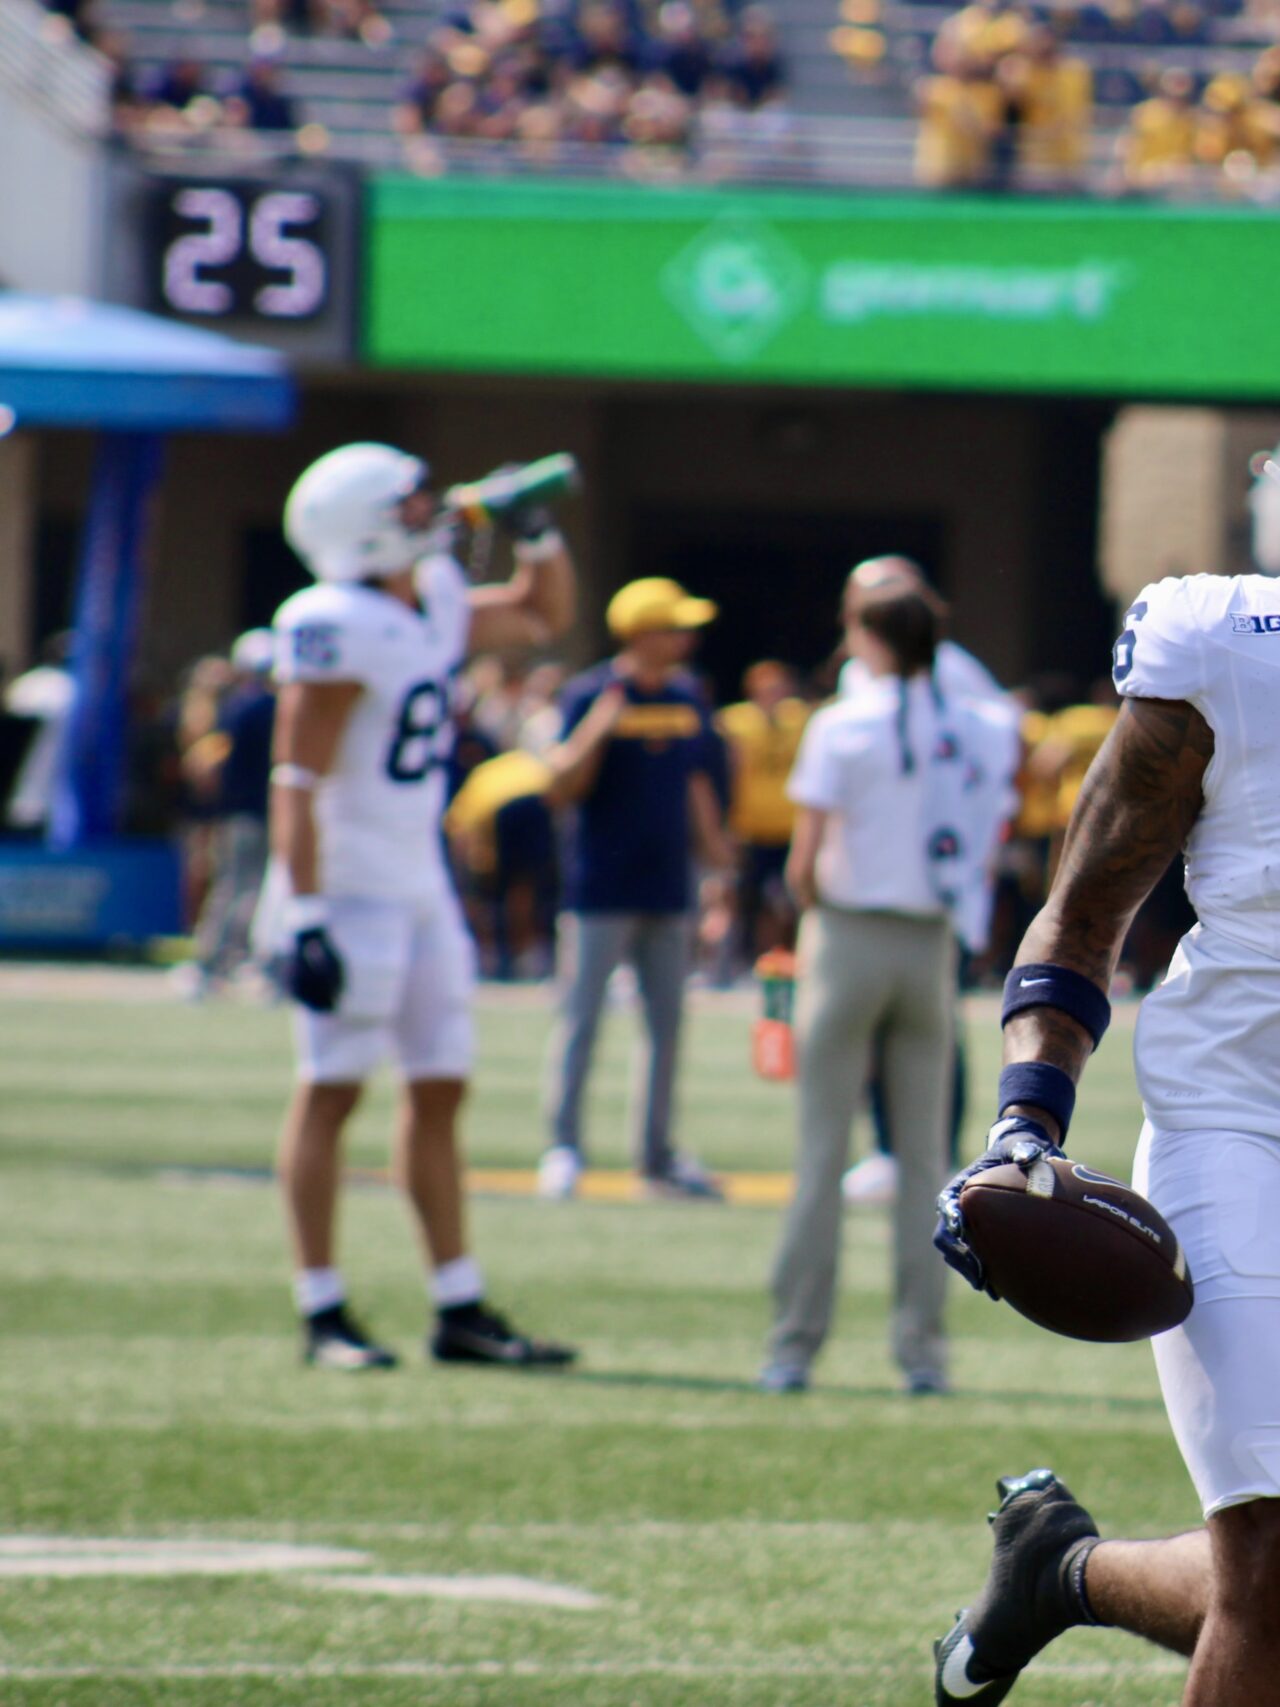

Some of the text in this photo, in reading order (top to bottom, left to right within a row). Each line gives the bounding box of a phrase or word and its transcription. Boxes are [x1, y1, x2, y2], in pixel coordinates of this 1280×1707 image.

[165, 187, 327, 315] 25
[1113, 601, 1148, 681] 6
[386, 680, 450, 782] 8
[1128, 1216, 1161, 1243] ELITE
